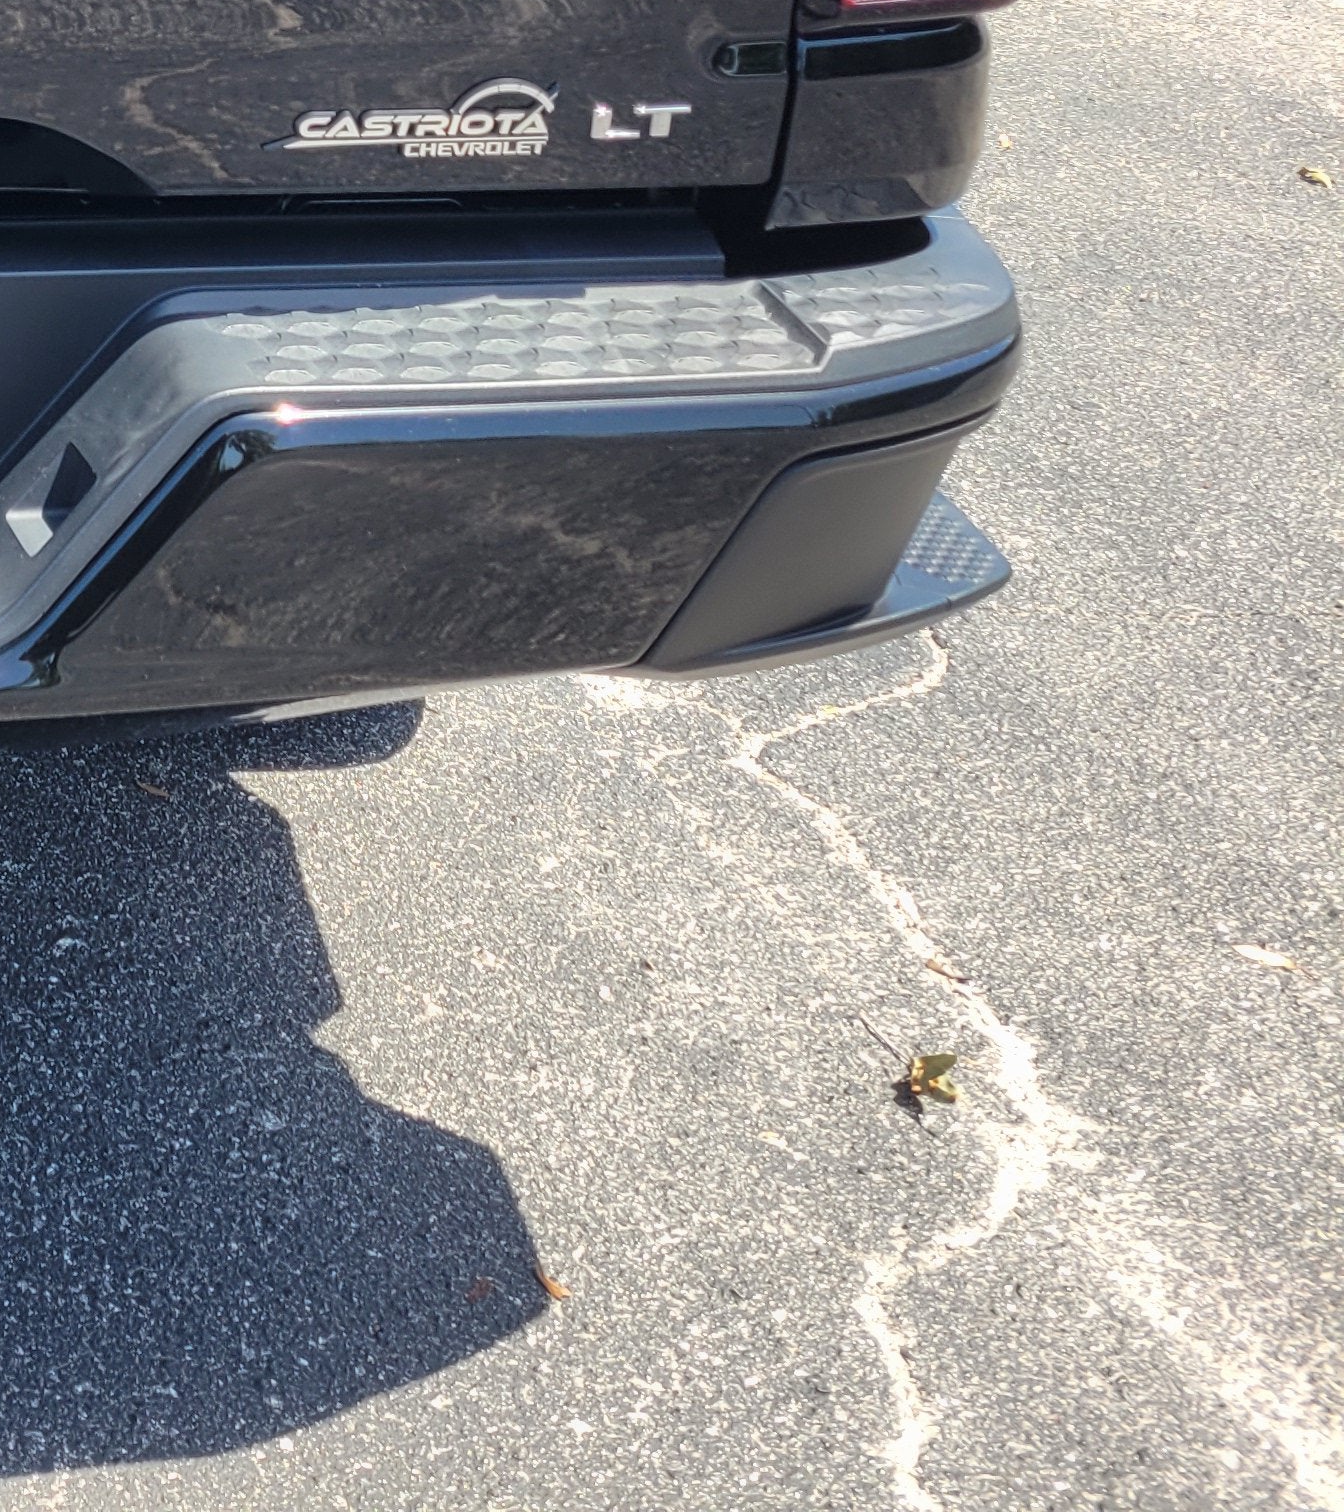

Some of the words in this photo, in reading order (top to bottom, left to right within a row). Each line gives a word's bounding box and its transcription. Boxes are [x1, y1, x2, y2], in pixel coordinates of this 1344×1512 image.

[297, 109, 550, 138] CASTRIOTA
[590, 103, 692, 140] LT
[404, 140, 547, 158] CHEVROLET
